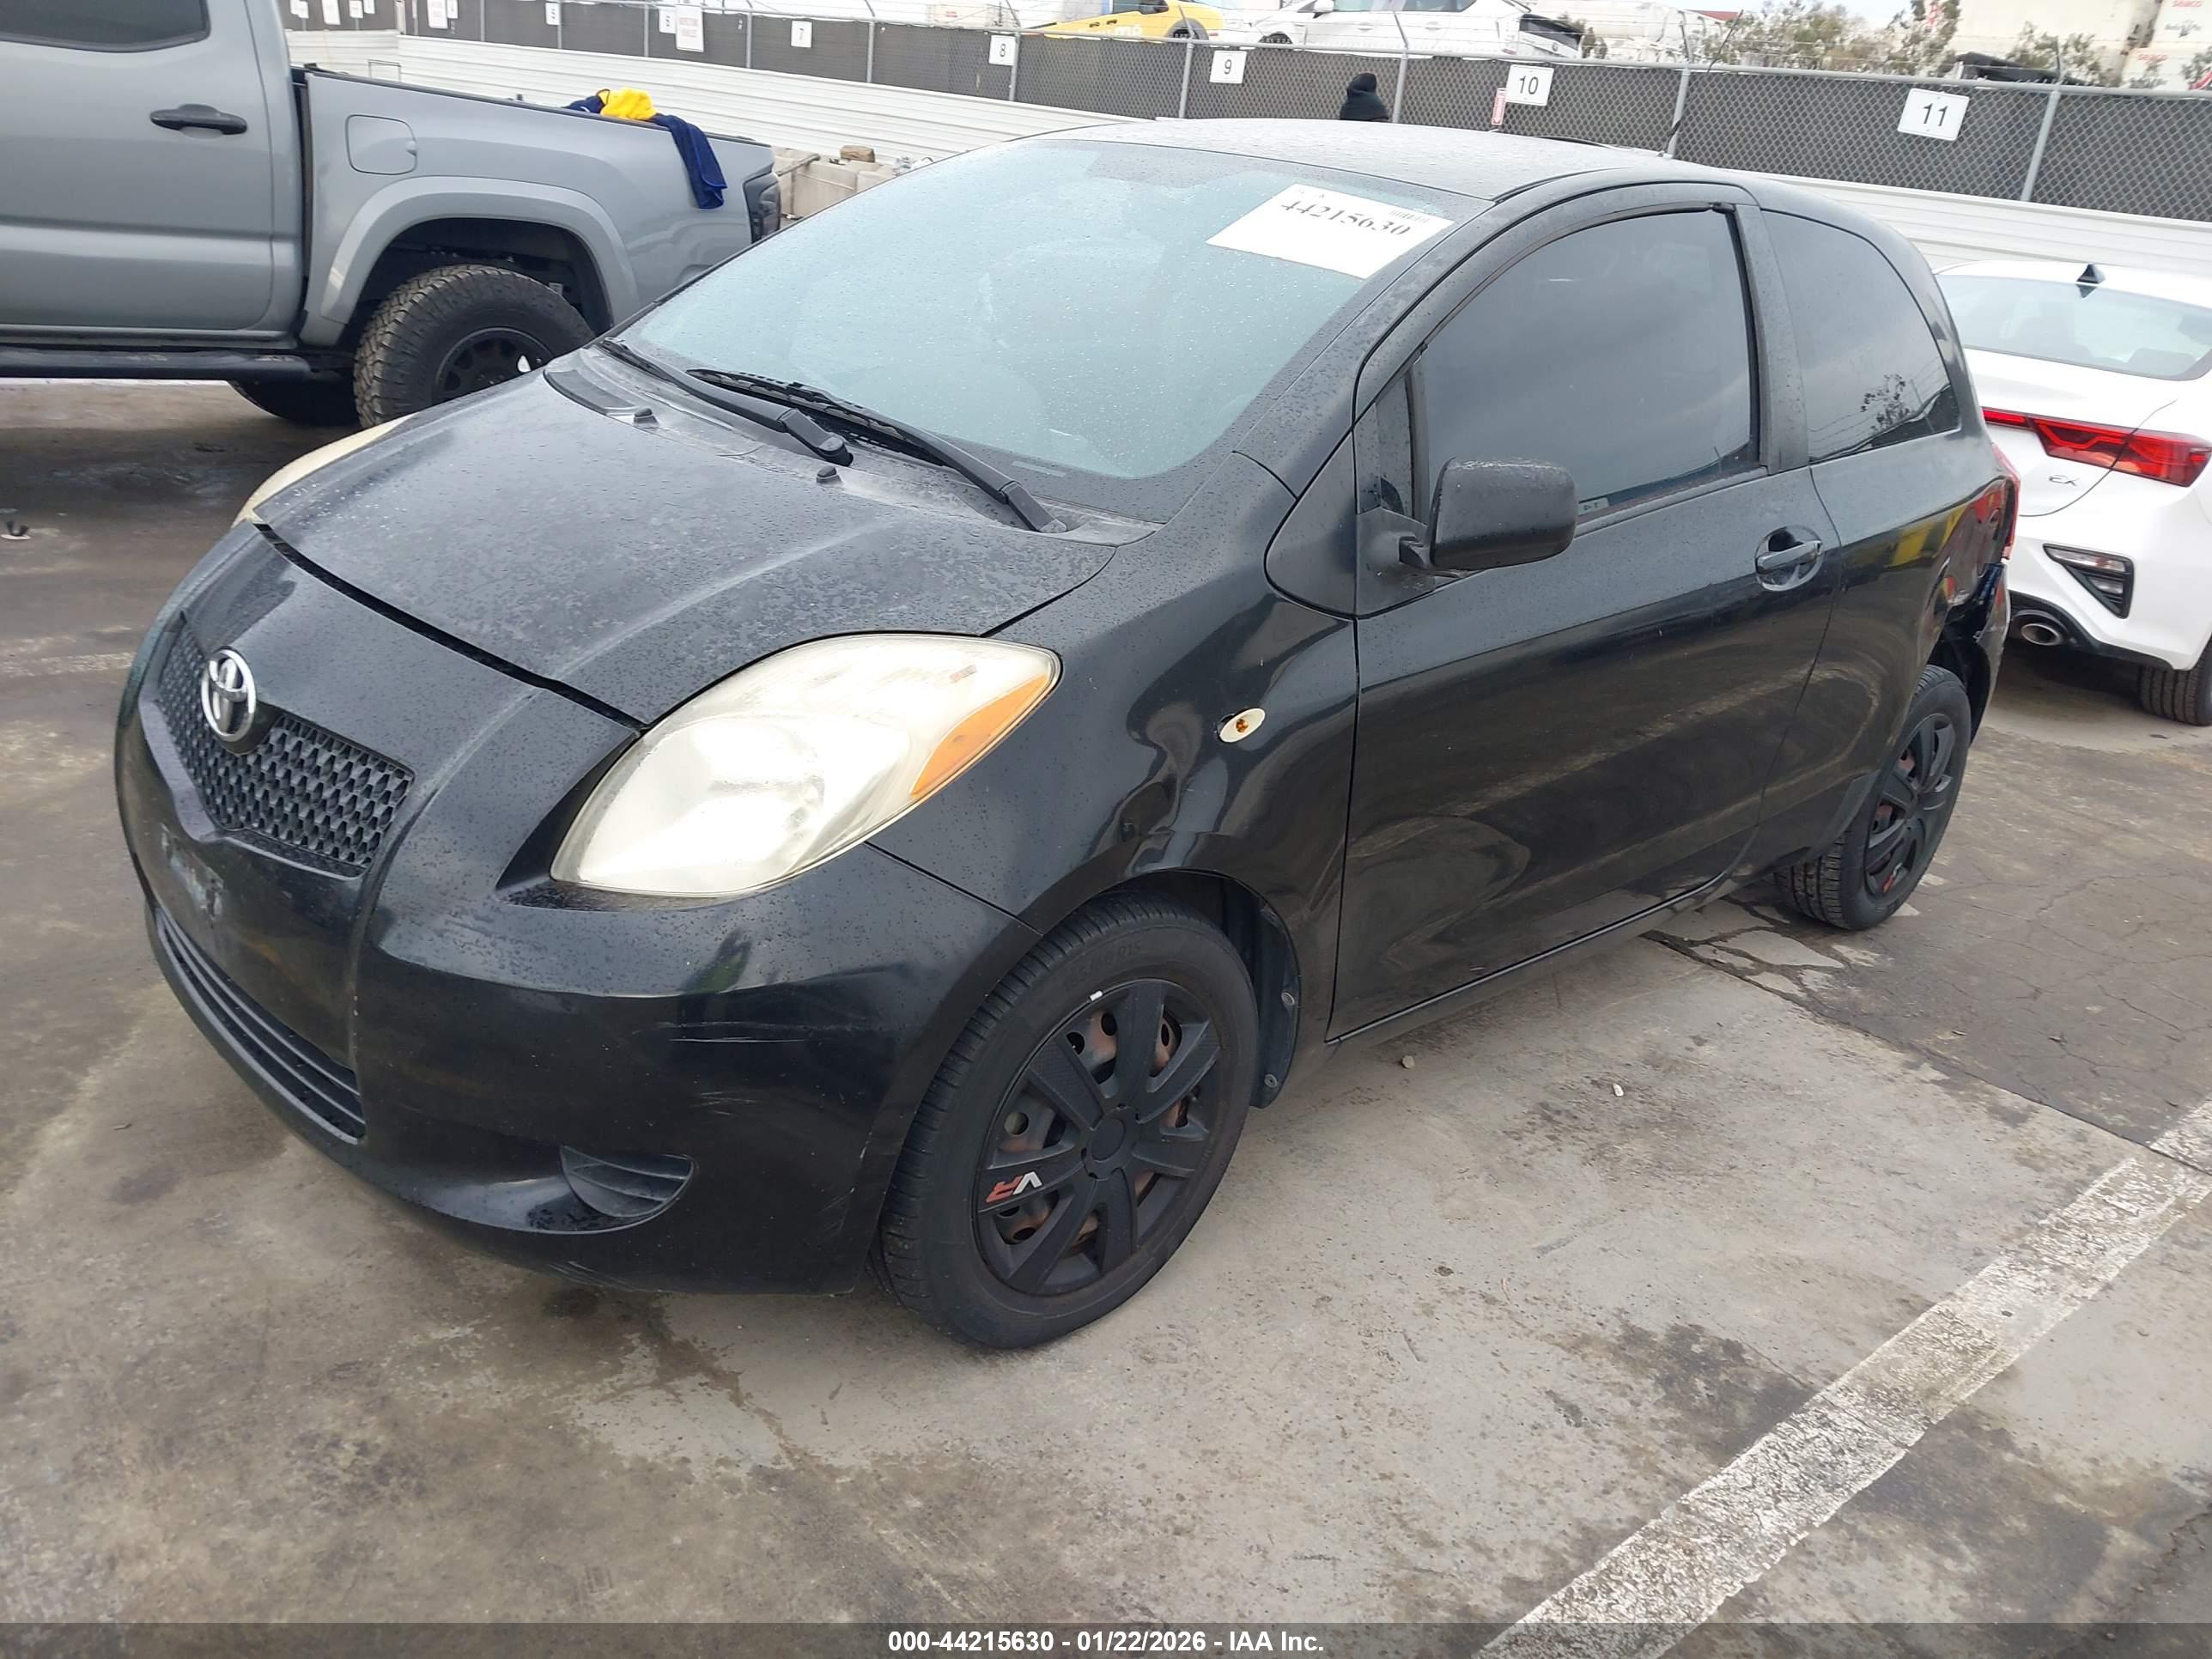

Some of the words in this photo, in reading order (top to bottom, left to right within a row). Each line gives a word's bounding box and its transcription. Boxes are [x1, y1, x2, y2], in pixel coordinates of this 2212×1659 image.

[1000, 43, 1006, 58] 8
[1224, 58, 1232, 75] 9
[1519, 75, 1539, 95] 10
[1923, 103, 1948, 127] 11
[1280, 200, 1412, 236] 44215630
[2049, 474, 2079, 487] EX
